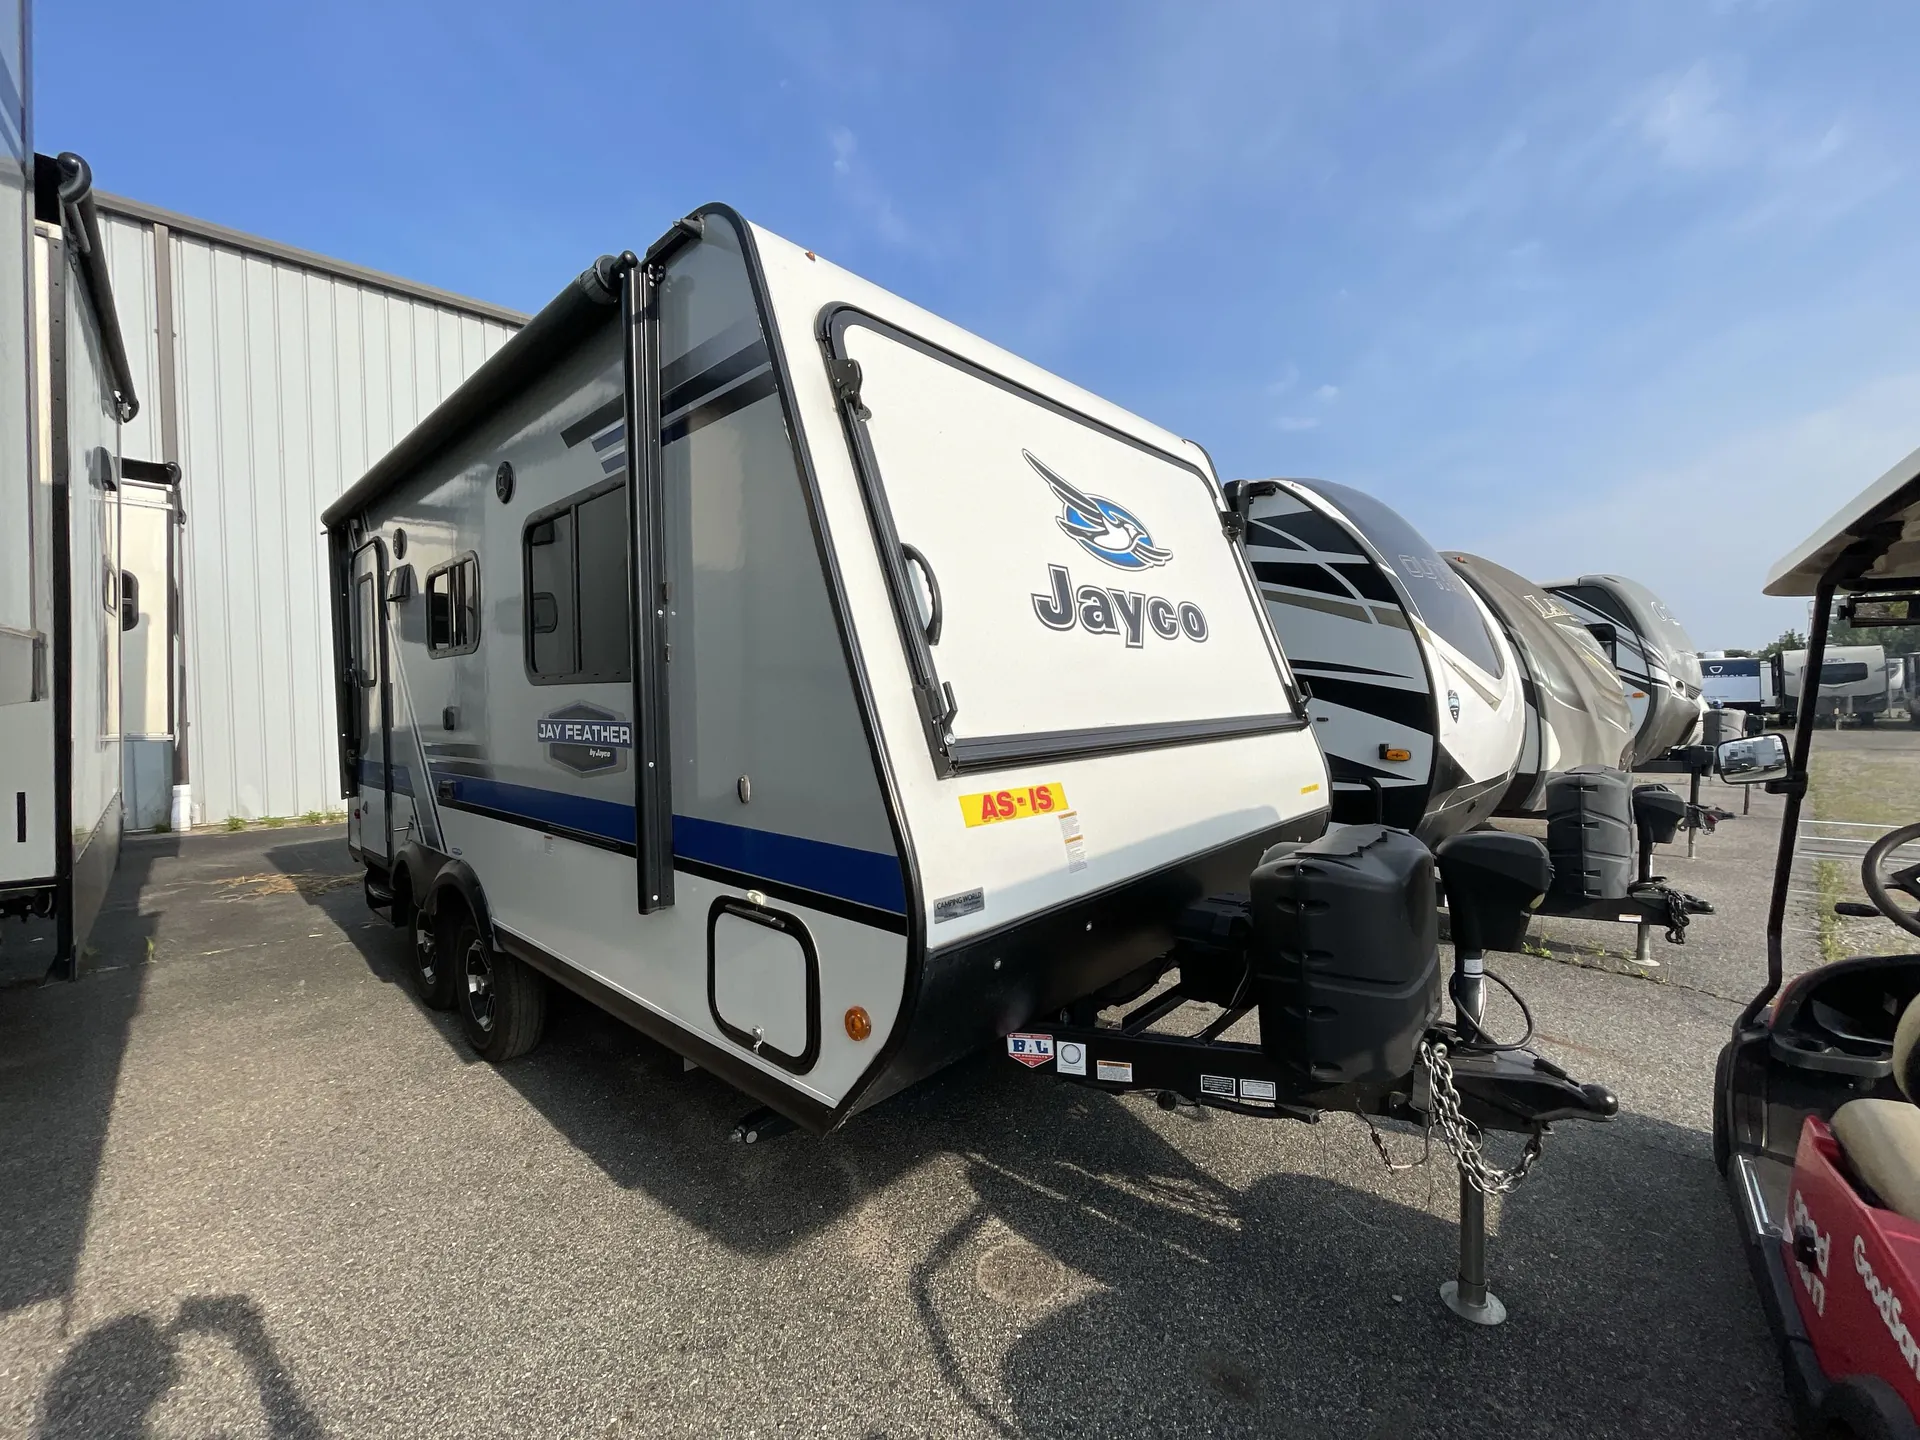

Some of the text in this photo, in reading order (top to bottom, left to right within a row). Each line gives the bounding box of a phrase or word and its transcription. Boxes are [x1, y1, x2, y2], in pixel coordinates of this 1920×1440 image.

[1030, 563, 1209, 649] Jayco
[538, 724, 631, 744] JAY FEATHER
[589, 748, 597, 758] by
[937, 896, 963, 910] CAMPING
[963, 891, 982, 903] WORLD
